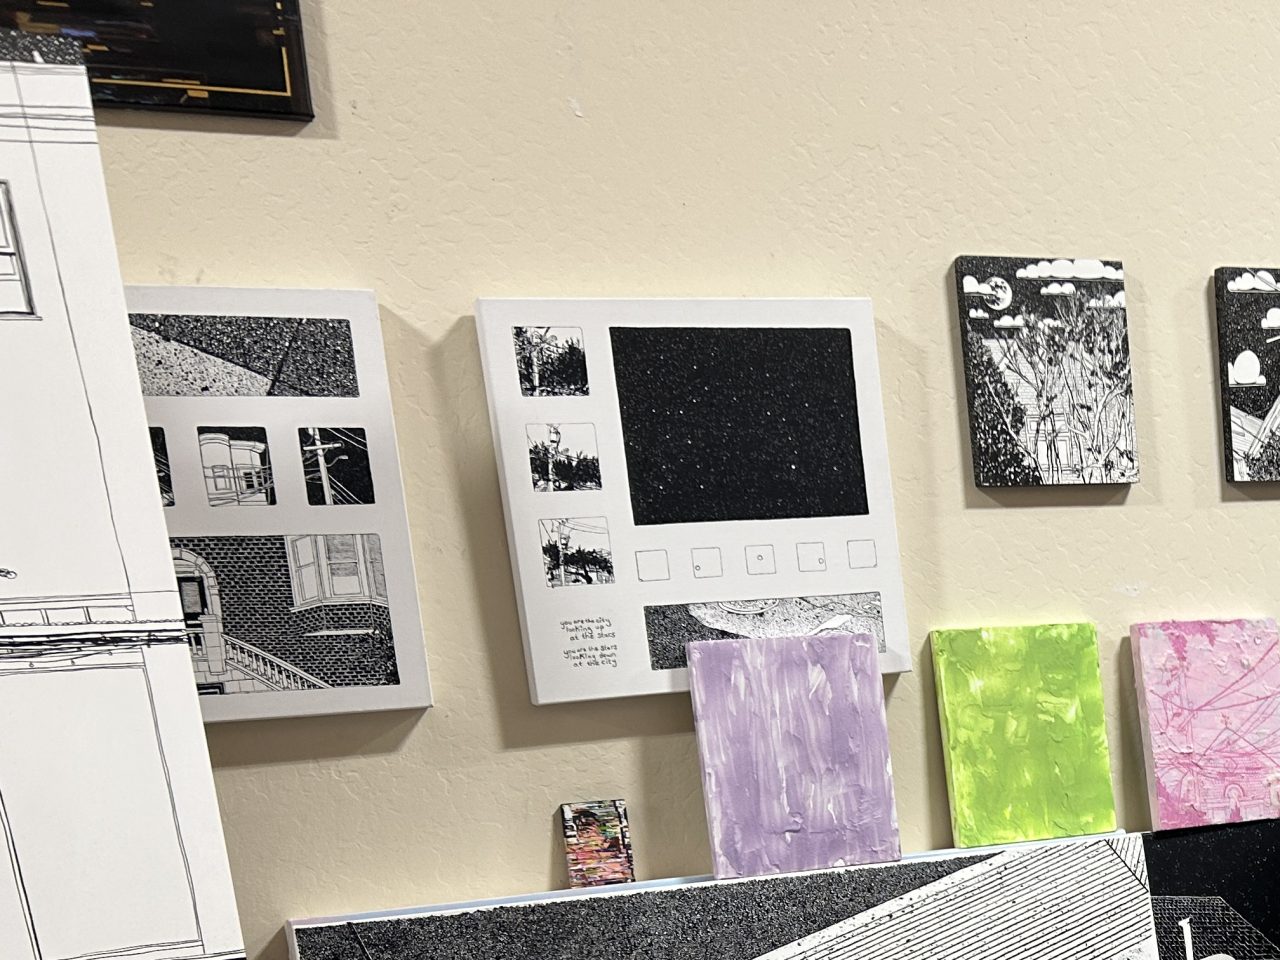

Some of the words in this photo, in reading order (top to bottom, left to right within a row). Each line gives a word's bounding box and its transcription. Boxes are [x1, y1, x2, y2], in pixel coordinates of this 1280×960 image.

[595, 616, 612, 628] city
[566, 624, 594, 635] looking
[595, 624, 605, 632] up
[569, 633, 580, 641] at
[582, 631, 595, 640] the
[597, 631, 616, 639] stars
[600, 644, 618, 652] stars
[601, 658, 618, 668] city
